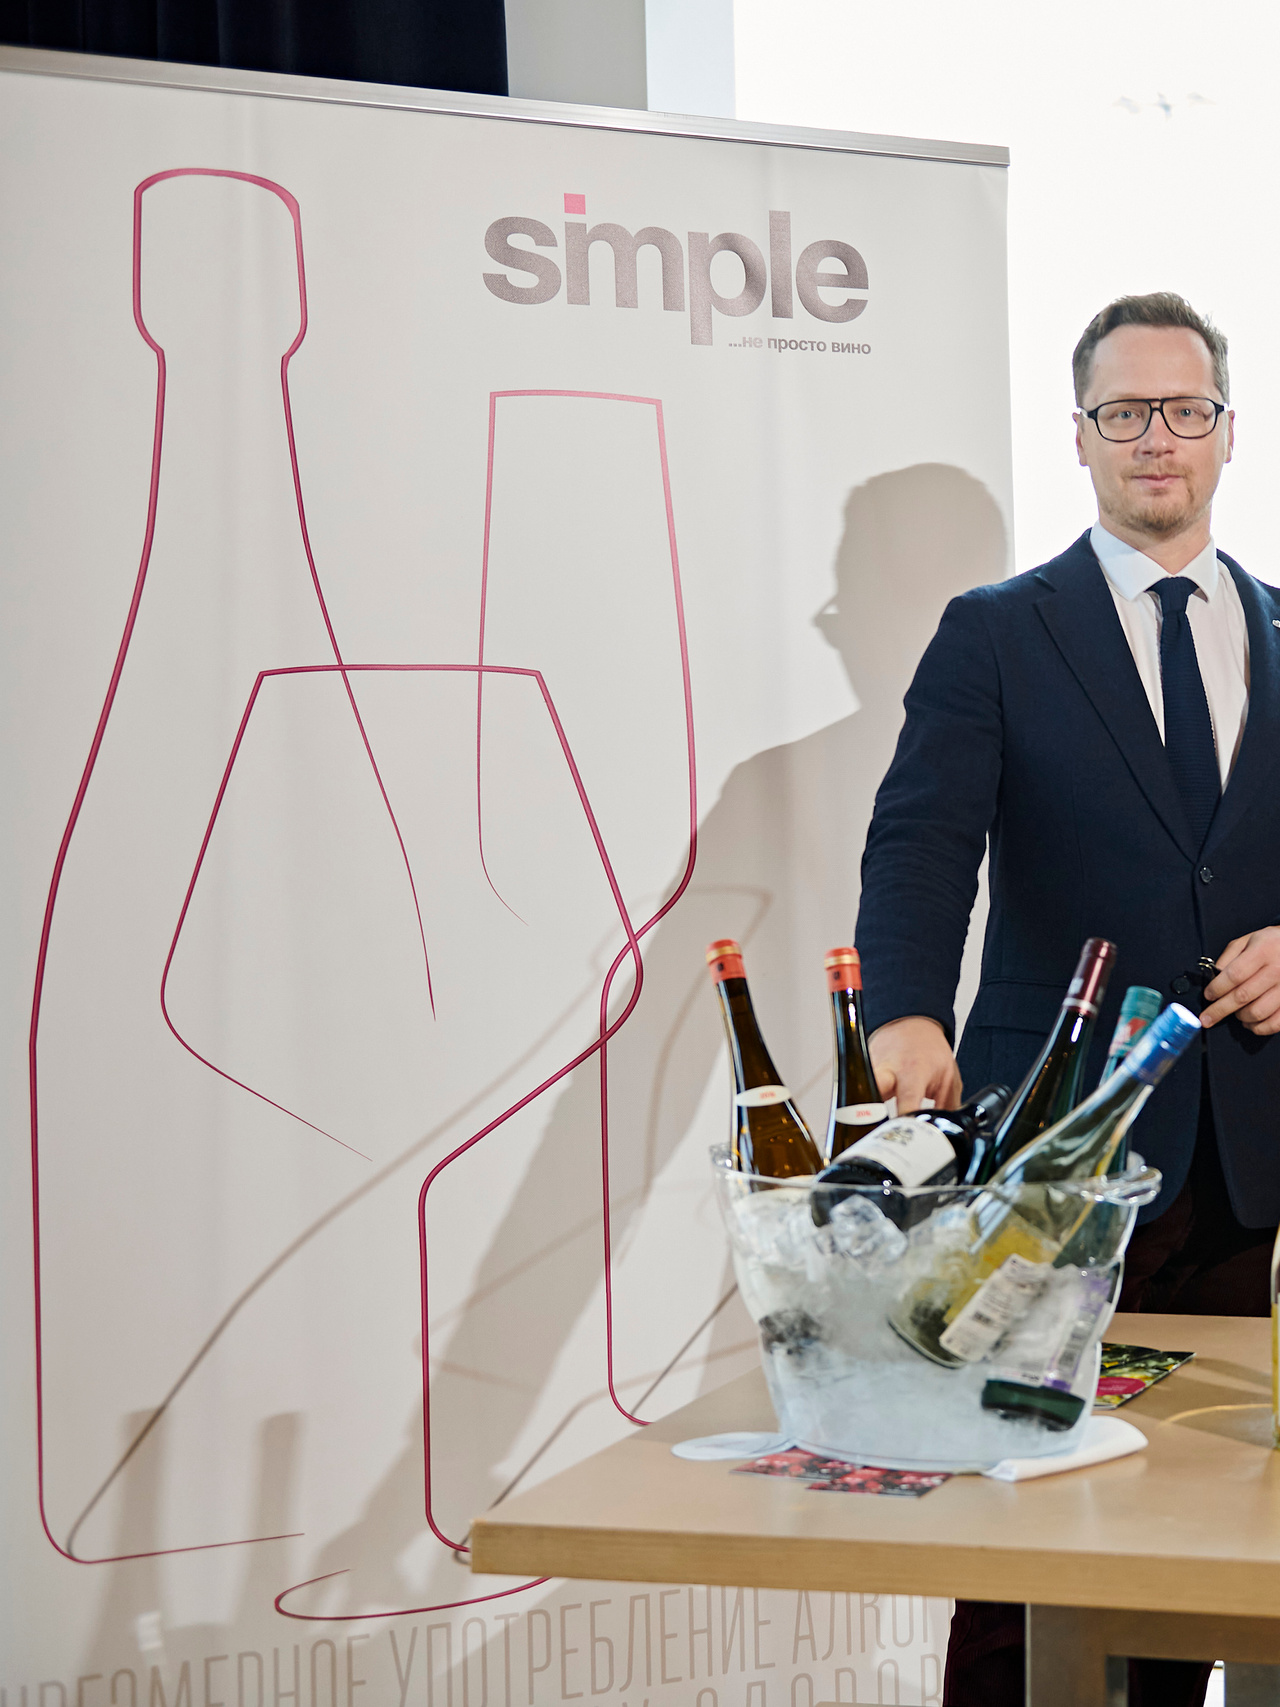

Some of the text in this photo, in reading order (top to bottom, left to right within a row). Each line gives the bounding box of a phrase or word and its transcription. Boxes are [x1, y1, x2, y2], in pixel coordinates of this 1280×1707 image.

[482, 193, 869, 346] simple
[728, 335, 872, 355] ...не просто вино
[389, 1587, 776, 1707] УПОТРЕБЛЕНИЕ
